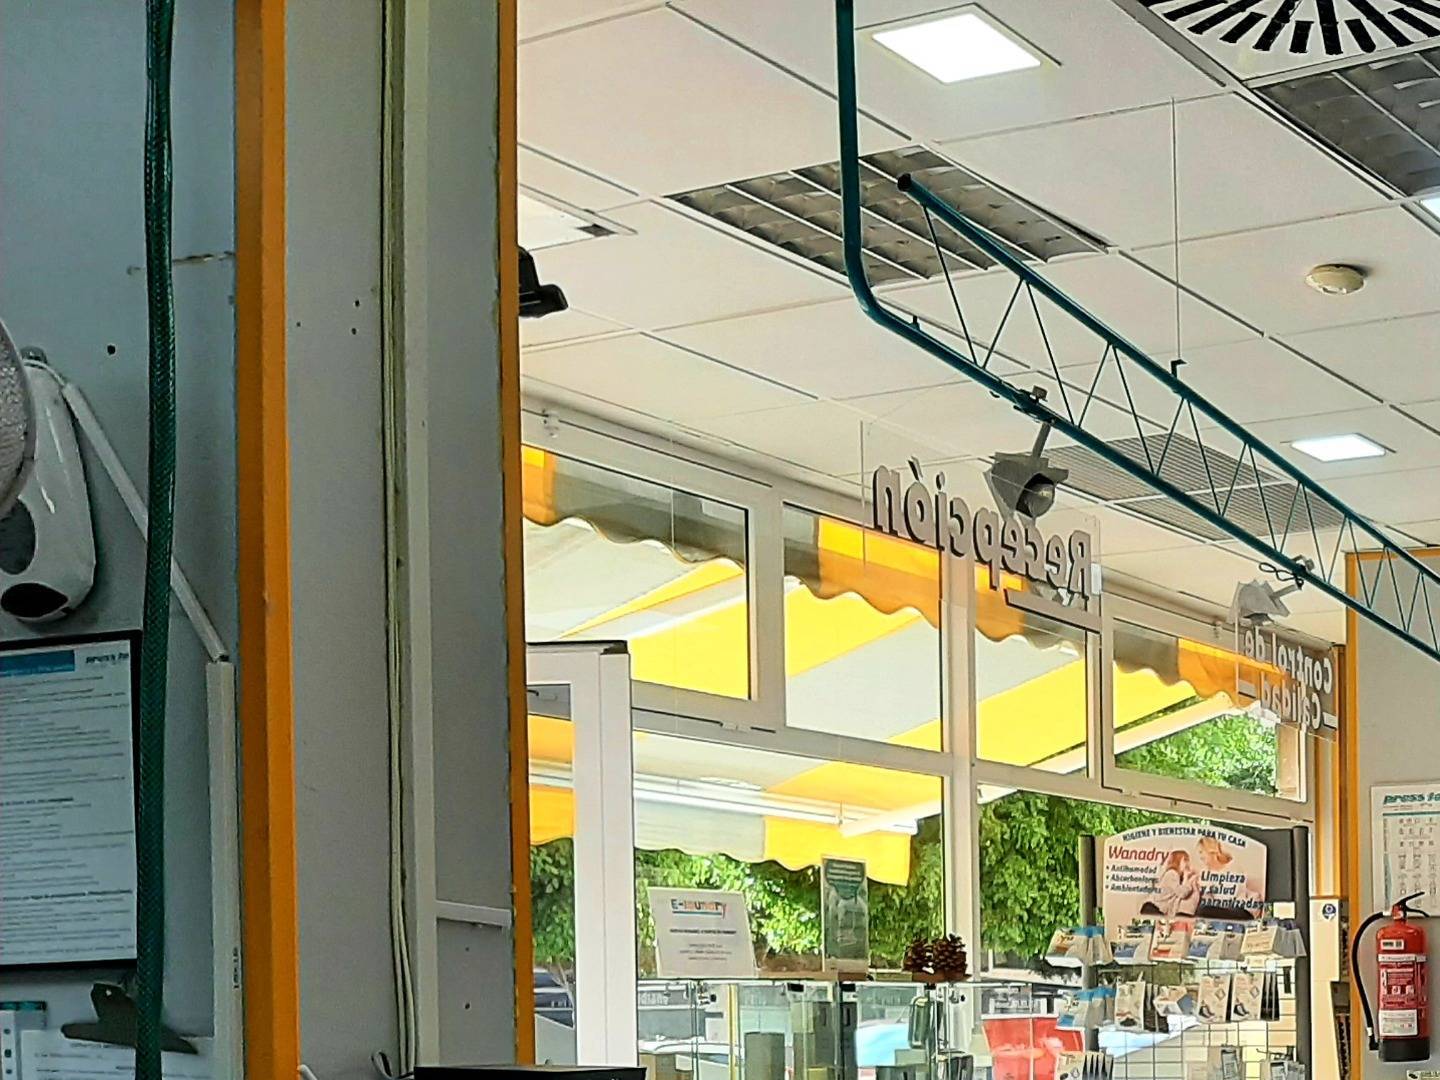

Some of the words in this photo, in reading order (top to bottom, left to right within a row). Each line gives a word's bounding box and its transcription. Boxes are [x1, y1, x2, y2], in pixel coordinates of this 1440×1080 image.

[1123, 828, 1150, 841] HIGIENE
[1152, 828, 1157, 836] Y
[1158, 827, 1196, 836] BIENESTAR
[1198, 828, 1216, 839] PARA
[1216, 831, 1227, 841] TU
[1227, 834, 1246, 848] CASA
[1108, 845, 1169, 865] Wanadry
[1200, 871, 1246, 886] Limpieza
[1206, 883, 1236, 895] salud
